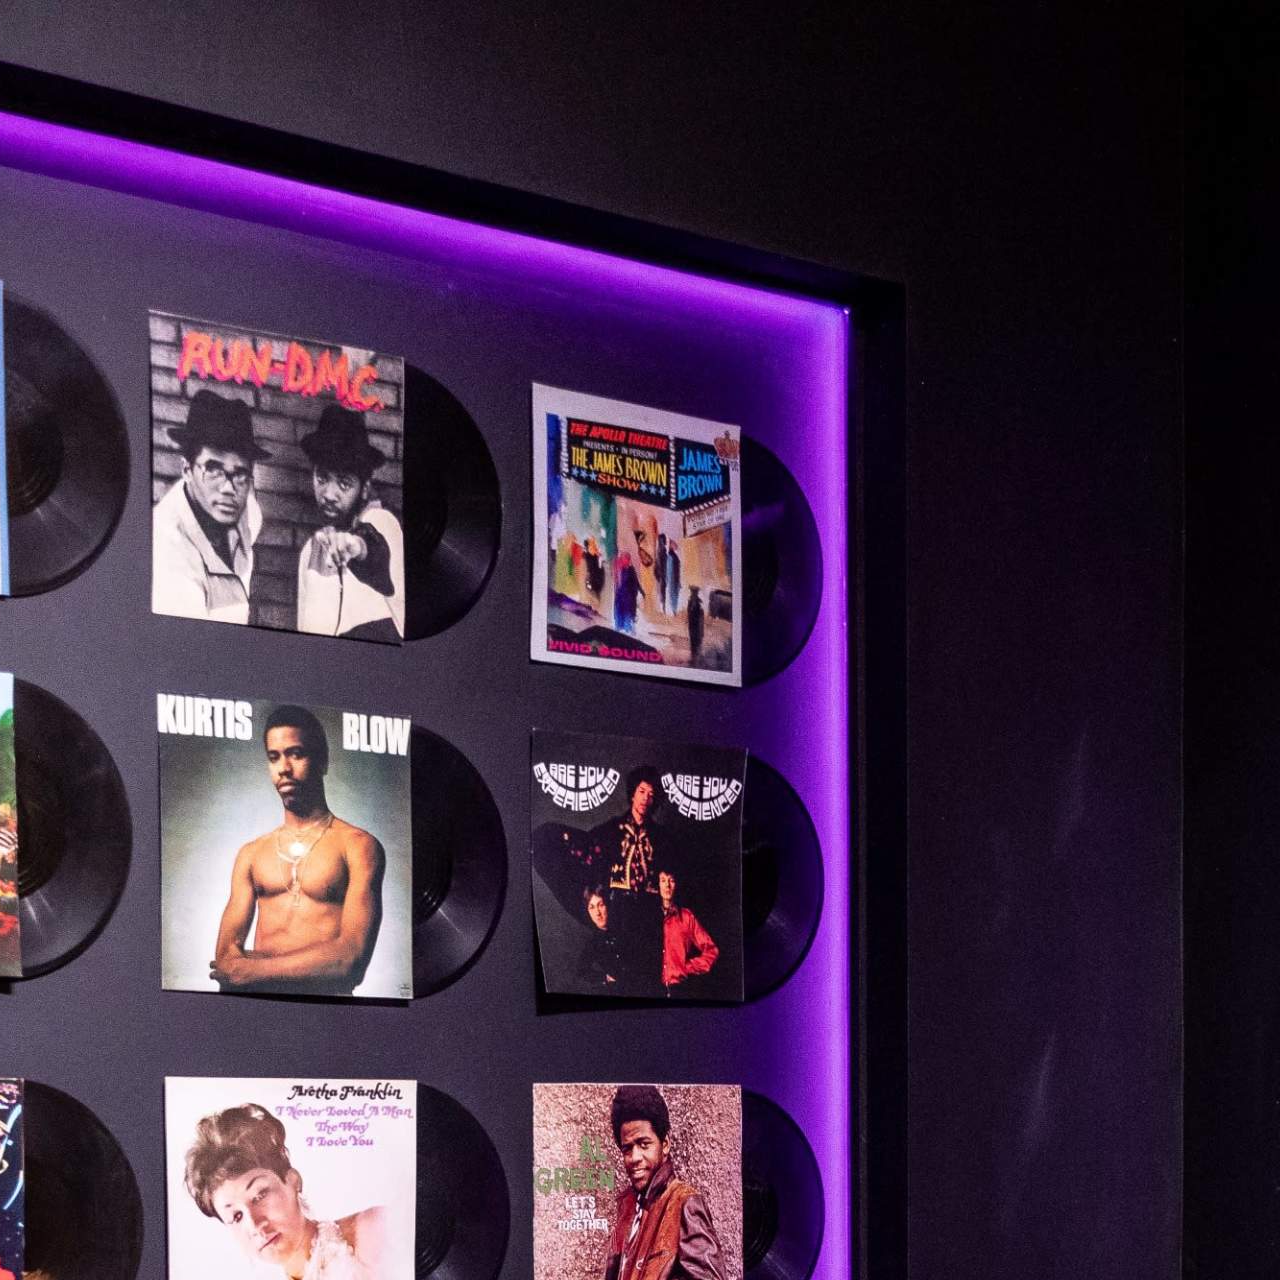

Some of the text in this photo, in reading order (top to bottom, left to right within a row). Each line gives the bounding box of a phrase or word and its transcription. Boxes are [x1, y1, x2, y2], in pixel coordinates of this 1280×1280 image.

[571, 423, 669, 449] THE APOLLO THEATRE
[572, 447, 667, 486] THE JAMES BROWN
[679, 448, 721, 474] JAMES
[597, 473, 641, 492] SHOW
[678, 474, 723, 500] BROWN
[598, 645, 661, 661] SOUND
[156, 693, 253, 741] KURTIS
[342, 712, 411, 756] BLOW
[533, 762, 620, 812] EXPERIENCED
[549, 763, 605, 788] ARE YOU
[676, 774, 728, 799] ARE YOU
[660, 773, 742, 821] EXPERIENCED
[287, 1082, 403, 1100] Aretha Franklin
[286, 1103, 324, 1119] Never
[325, 1103, 368, 1117] Loved
[381, 1105, 414, 1119] Man
[315, 1119, 369, 1135] The Way
[316, 1137, 348, 1147] Love
[349, 1135, 373, 1146] You
[579, 1135, 608, 1162] AL
[534, 1167, 614, 1196] GREEN
[565, 1196, 596, 1209] LET'S
[572, 1208, 598, 1220] STAY
[557, 1218, 608, 1232] TOGETHER
